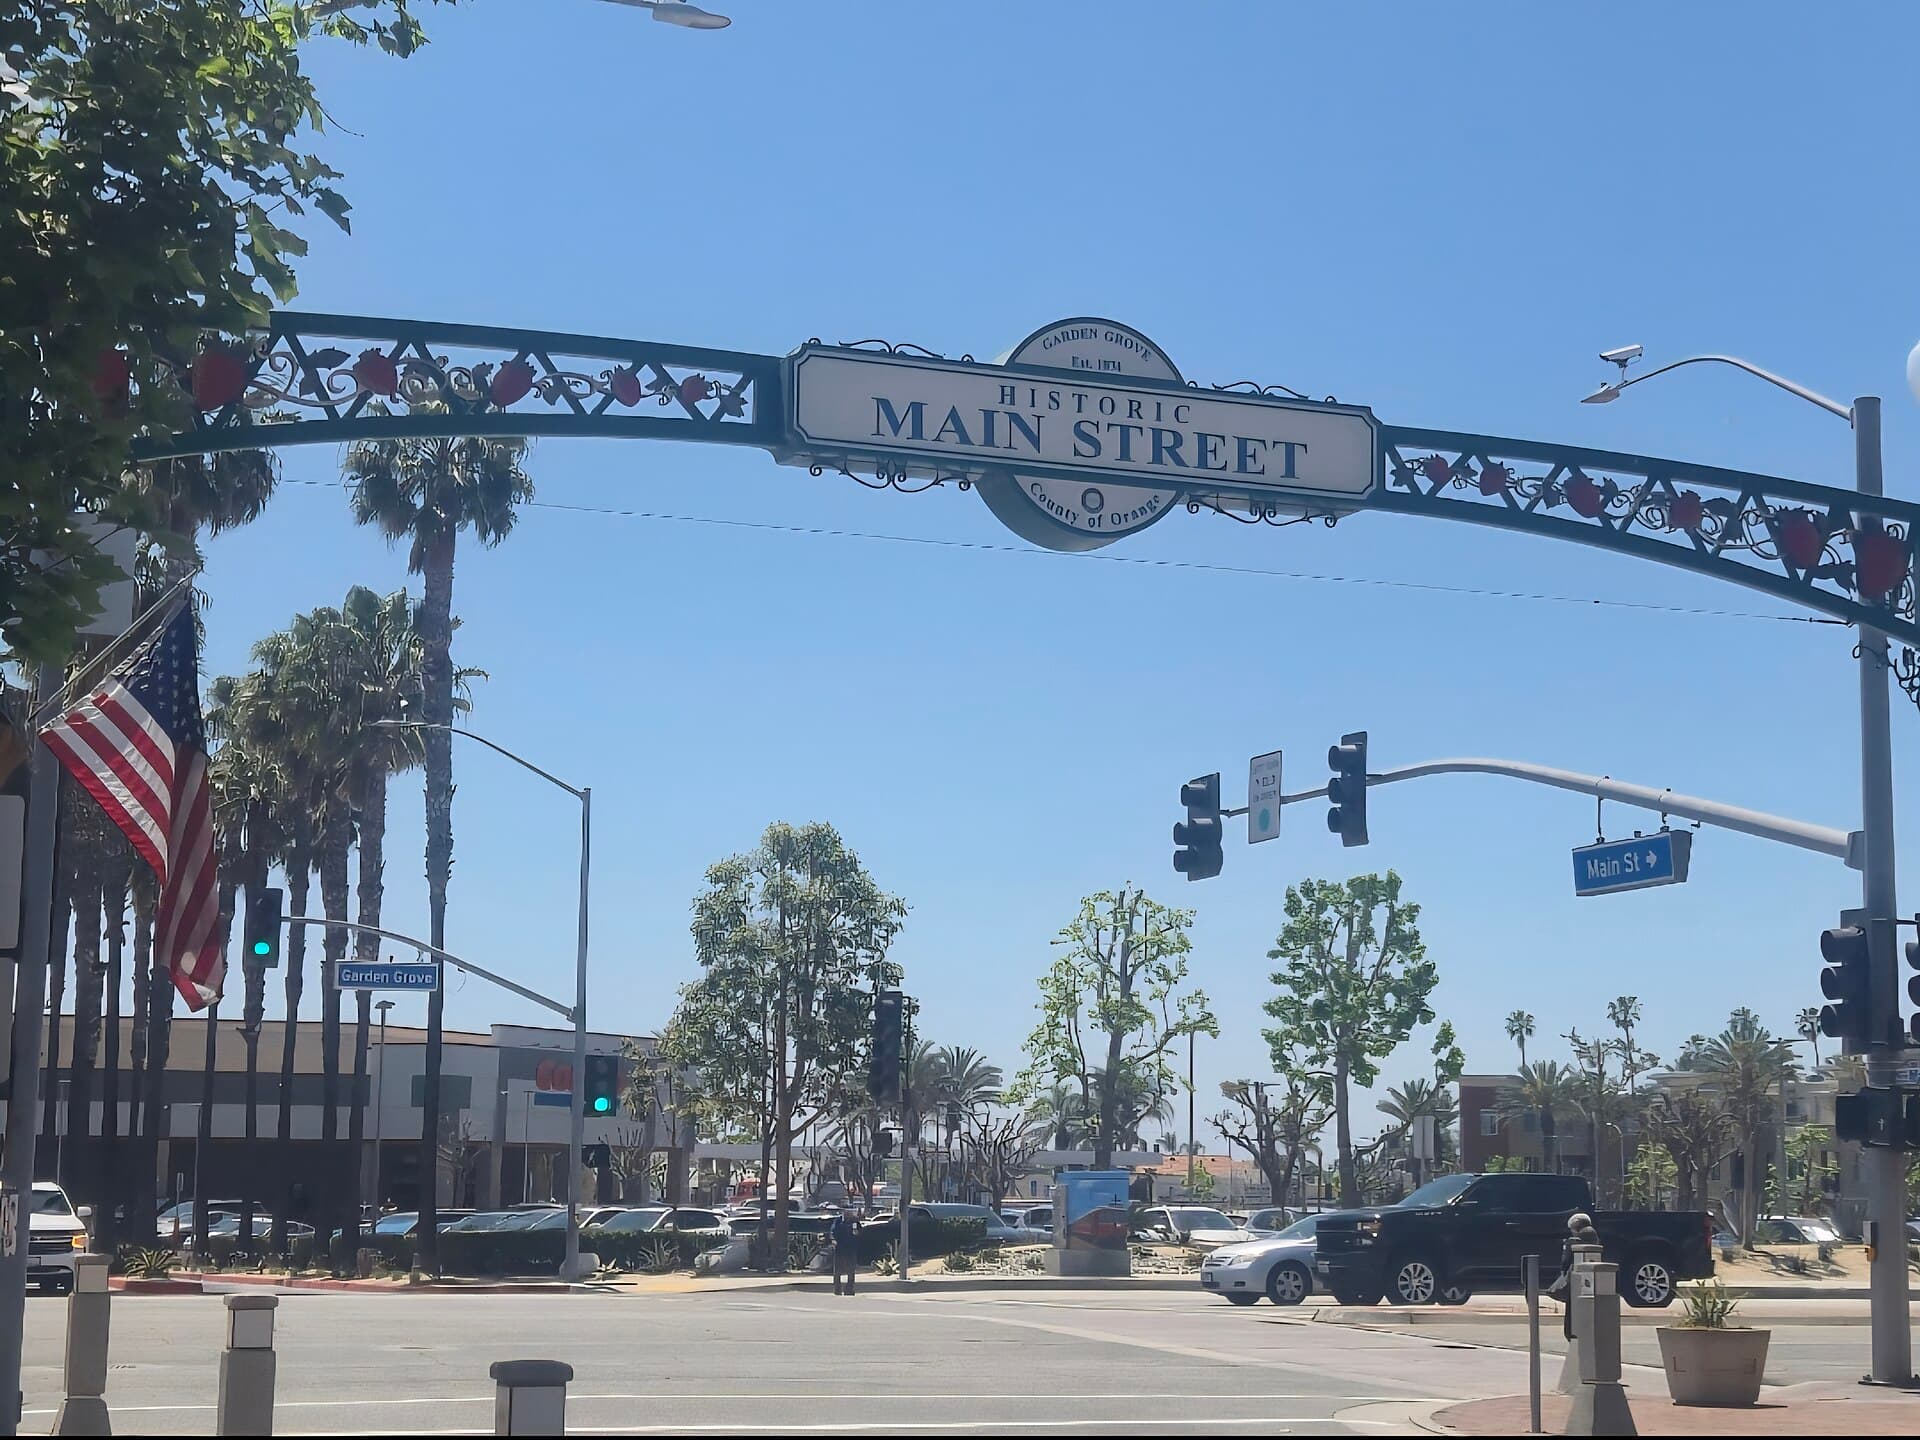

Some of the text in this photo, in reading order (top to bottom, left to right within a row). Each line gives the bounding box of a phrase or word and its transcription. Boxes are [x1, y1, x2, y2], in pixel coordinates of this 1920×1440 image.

[1042, 327, 1152, 362] GARDEN GROVE
[998, 384, 1190, 424] HISTORIC
[871, 396, 1308, 480] MAIN STREET
[1030, 482, 1160, 529] County of Orange
[1587, 852, 1641, 880] Main St
[341, 968, 433, 984] Garden Grove
